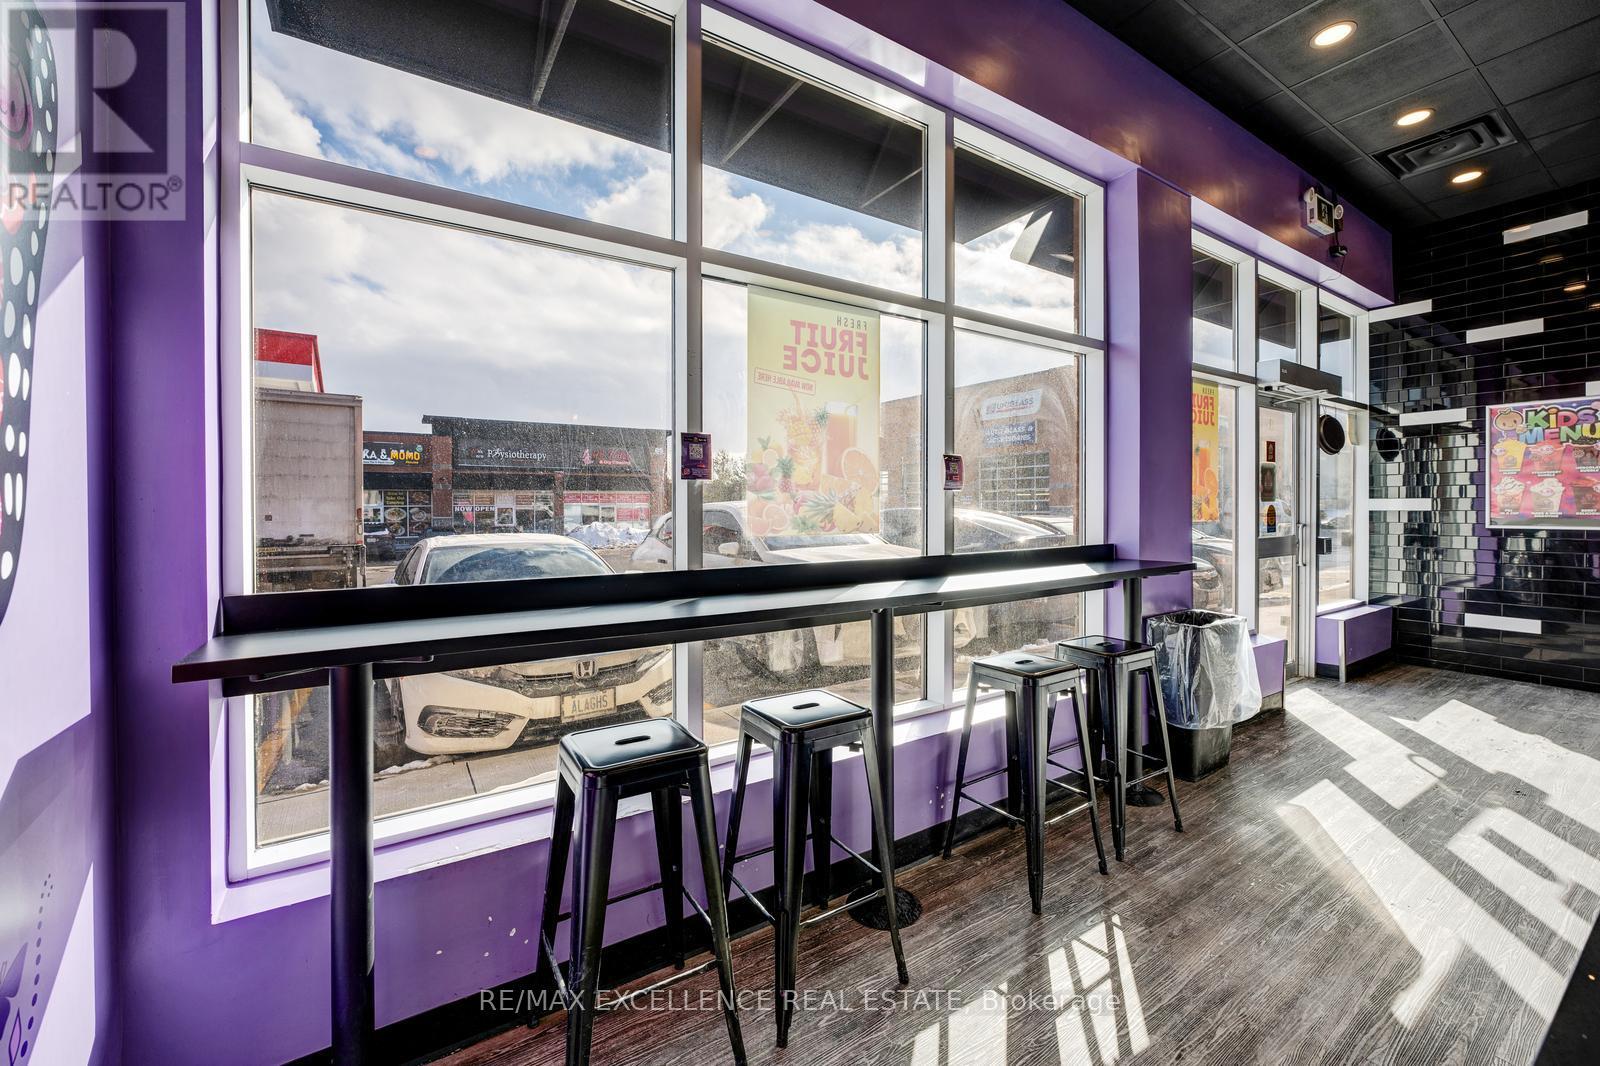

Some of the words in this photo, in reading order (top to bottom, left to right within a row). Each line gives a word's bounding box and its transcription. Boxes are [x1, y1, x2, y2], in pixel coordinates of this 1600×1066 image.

[380, 448, 388, 460] &
[390, 449, 420, 460] MOMO
[487, 447, 546, 461] Physiotherapy
[571, 694, 608, 714] ALAGHS
